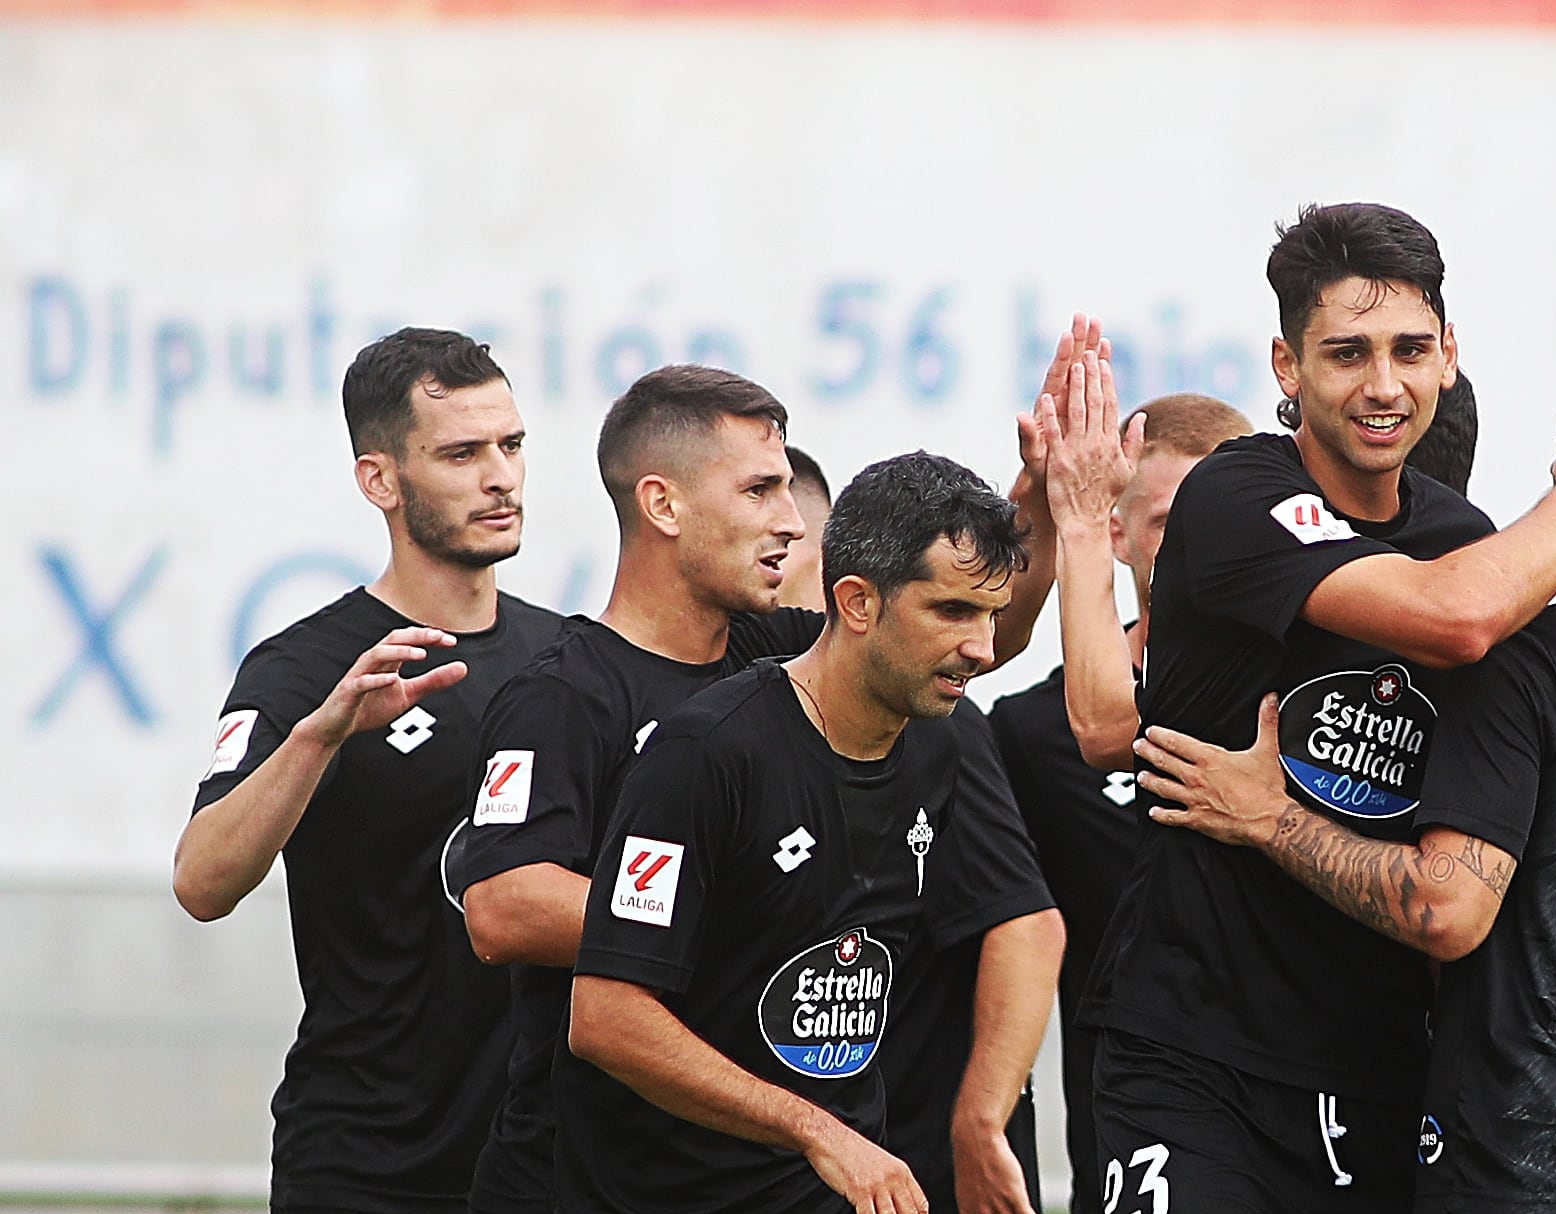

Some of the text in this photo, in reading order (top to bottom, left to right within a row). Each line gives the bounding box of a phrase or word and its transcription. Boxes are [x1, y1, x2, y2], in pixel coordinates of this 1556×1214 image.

[812, 280, 965, 400] 56
[1312, 690, 1425, 755] Estrella
[1307, 725, 1406, 787] Galicia
[479, 802, 519, 816] LALIGA
[619, 893, 665, 914] LALIGA
[791, 966, 883, 1002] Estrella
[792, 1001, 877, 1039] Galicia
